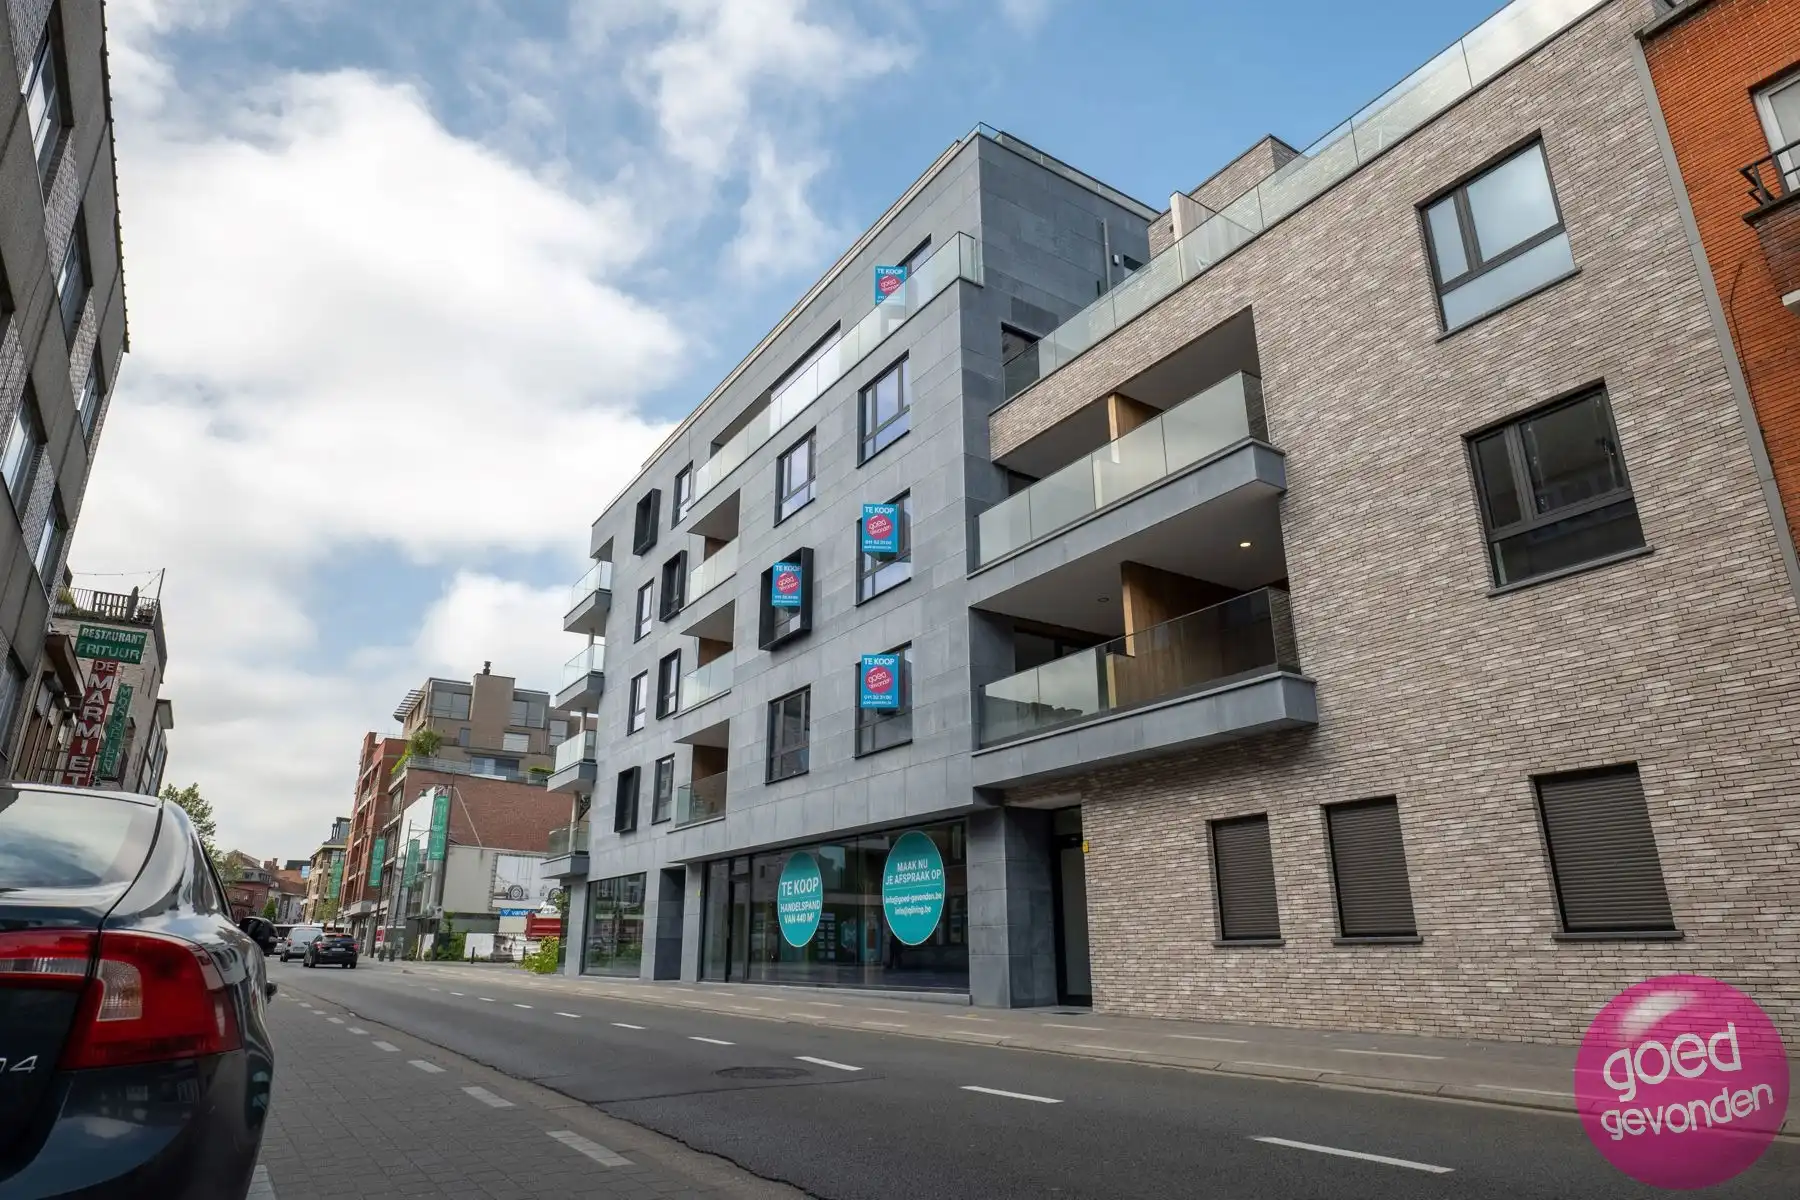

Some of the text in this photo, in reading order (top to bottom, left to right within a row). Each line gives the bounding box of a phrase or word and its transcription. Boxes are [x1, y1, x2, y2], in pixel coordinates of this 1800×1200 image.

[865, 506, 895, 514] TE KOOP
[81, 627, 145, 644] RESTAURANT
[77, 643, 140, 660] FRITUUR
[94, 661, 116, 673] DE
[863, 657, 895, 666] TE KOOP
[66, 673, 115, 786] MARMIET
[897, 858, 928, 873] MAAK NU
[885, 869, 942, 885] JE AFSPRAAK OP
[782, 877, 819, 897] TE KOOP
[780, 900, 821, 913] HANDELSPAND
[784, 914, 796, 925] VAN
